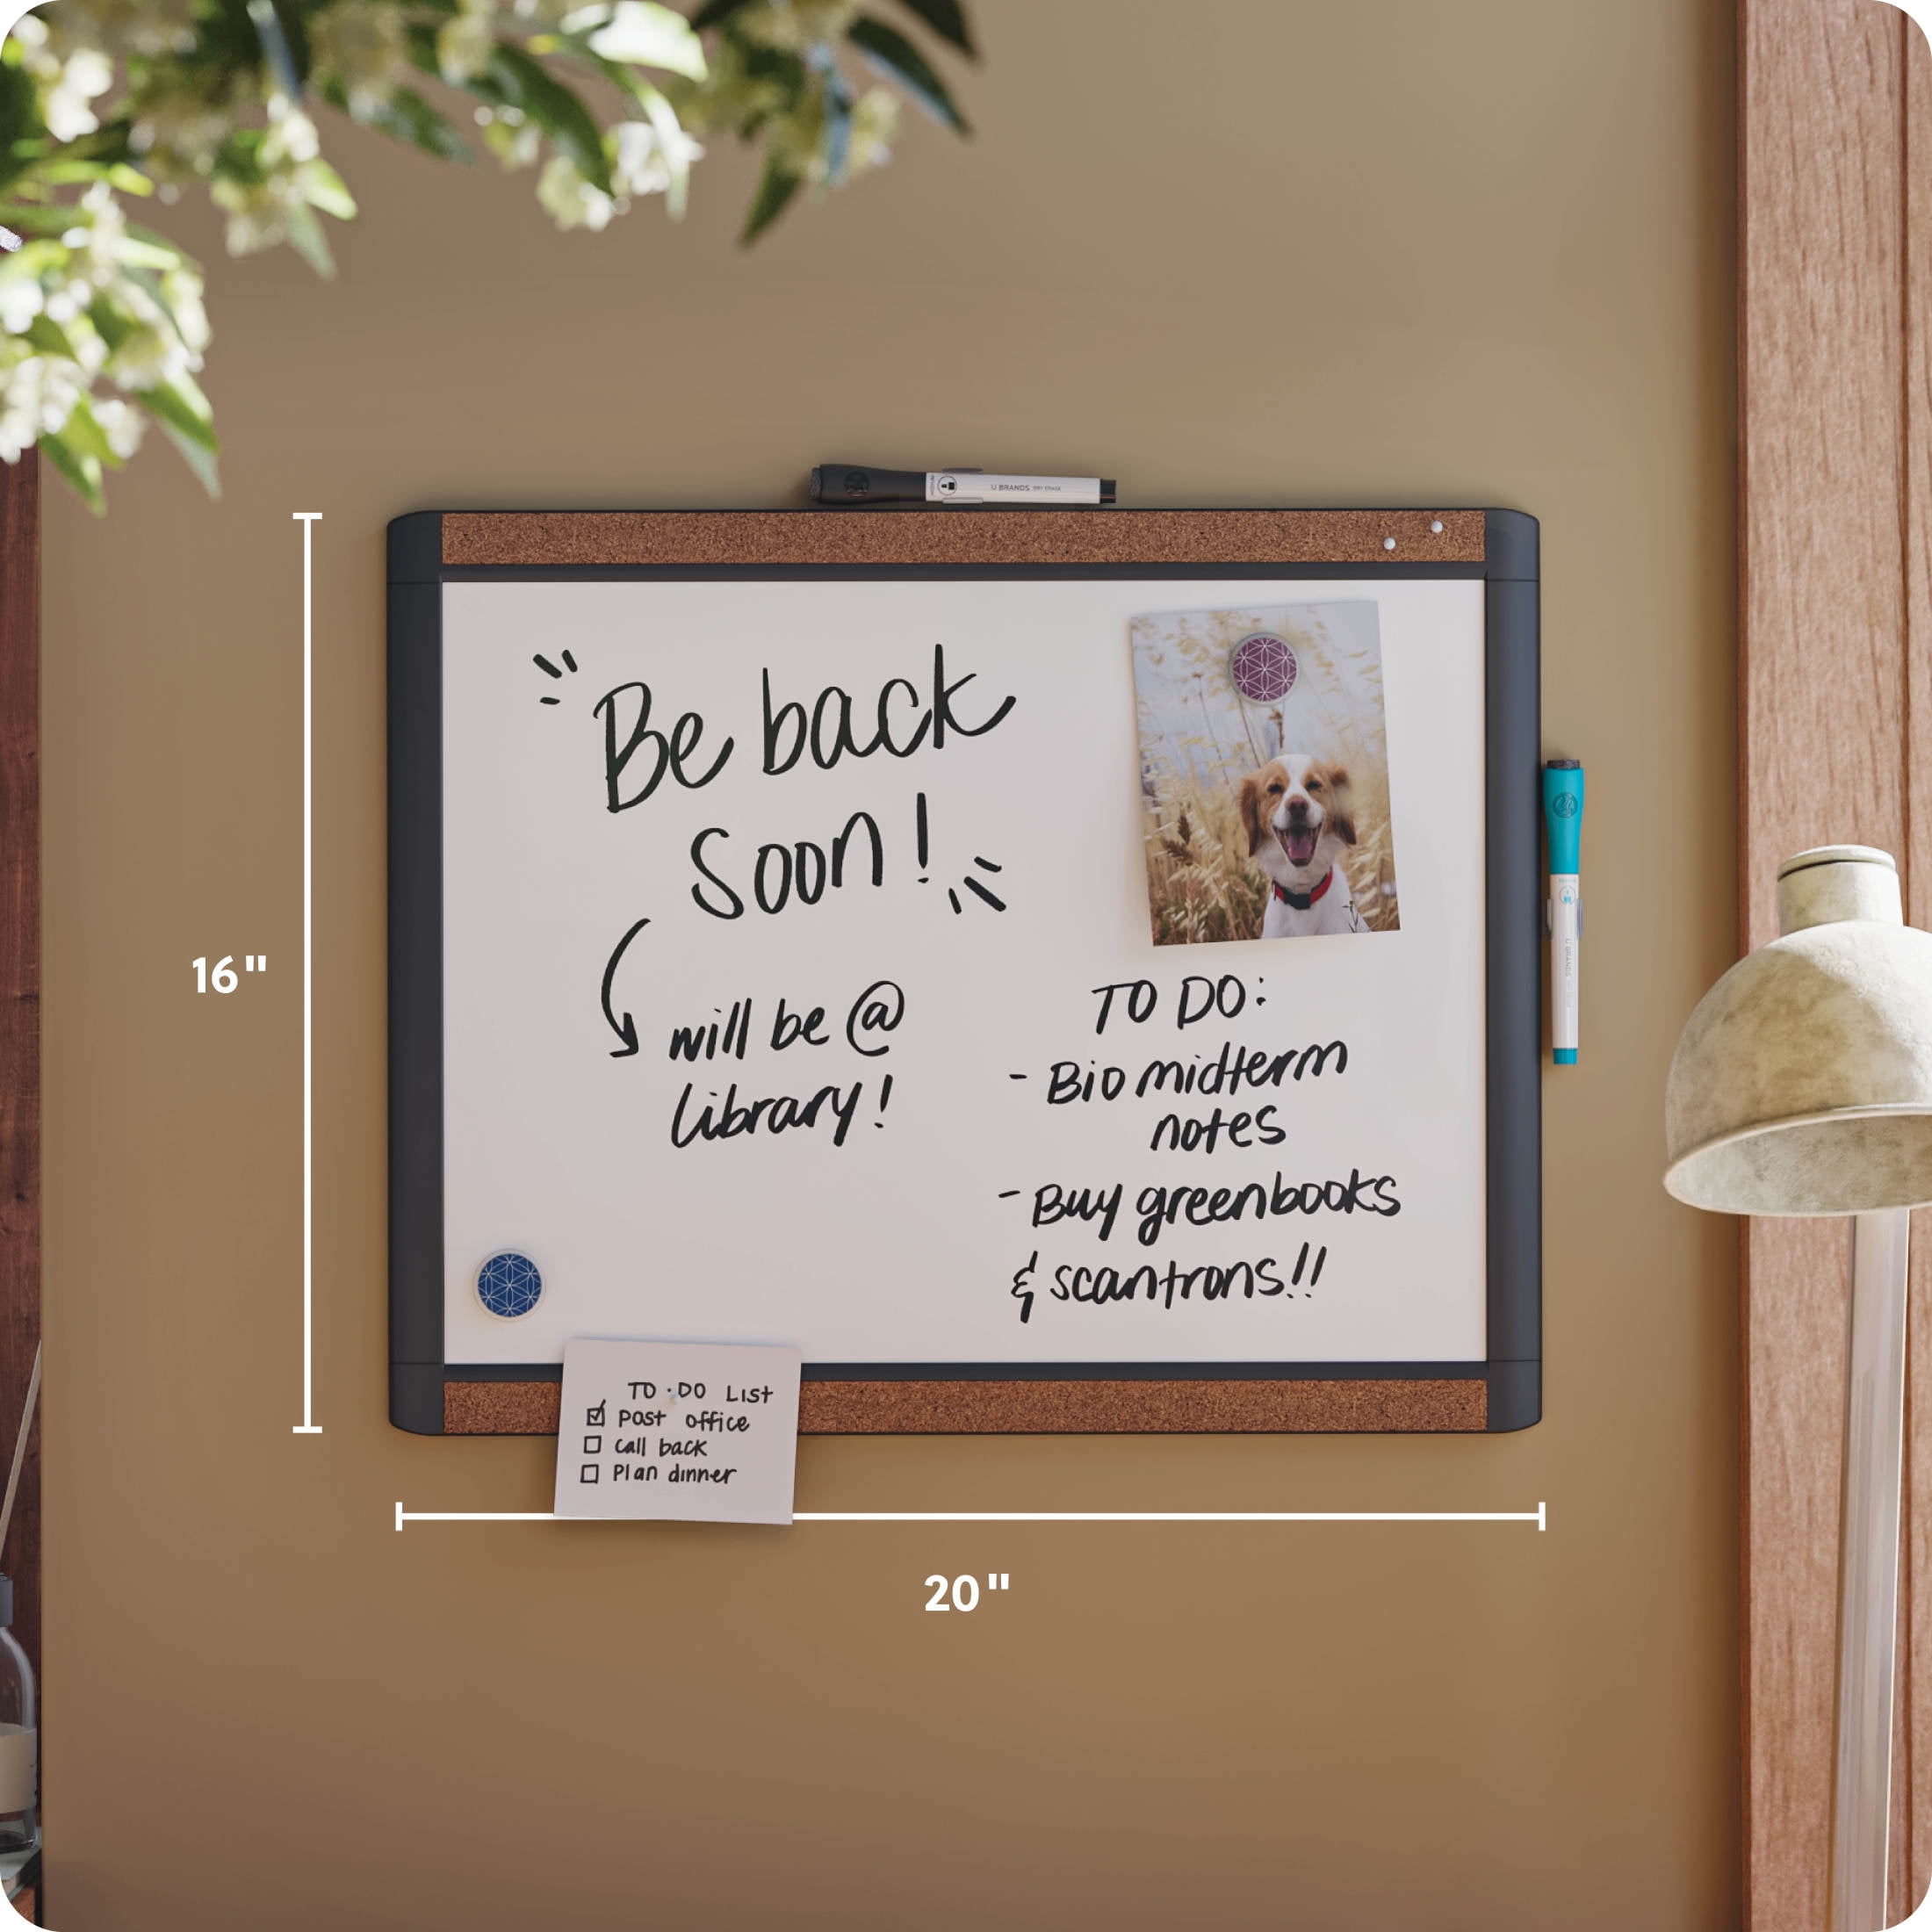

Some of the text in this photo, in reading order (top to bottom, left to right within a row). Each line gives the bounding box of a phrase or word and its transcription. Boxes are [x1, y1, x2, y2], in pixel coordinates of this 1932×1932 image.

[593, 644, 1017, 814] Be back
[668, 980, 905, 1063] will be @
[1091, 974, 1266, 1035] TO DO:
[1047, 1060, 1126, 1105] Bio
[1135, 1040, 1348, 1098] midterm
[1150, 1105, 1287, 1155] notes
[1032, 1183, 1123, 1242] Buy
[1135, 1168, 1402, 1247] greenbooks
[1049, 1242, 1328, 1309] scantrons!!
[659, 1438, 708, 1458] back
[685, 1410, 751, 1433] office
[667, 1463, 738, 1485] dinner
